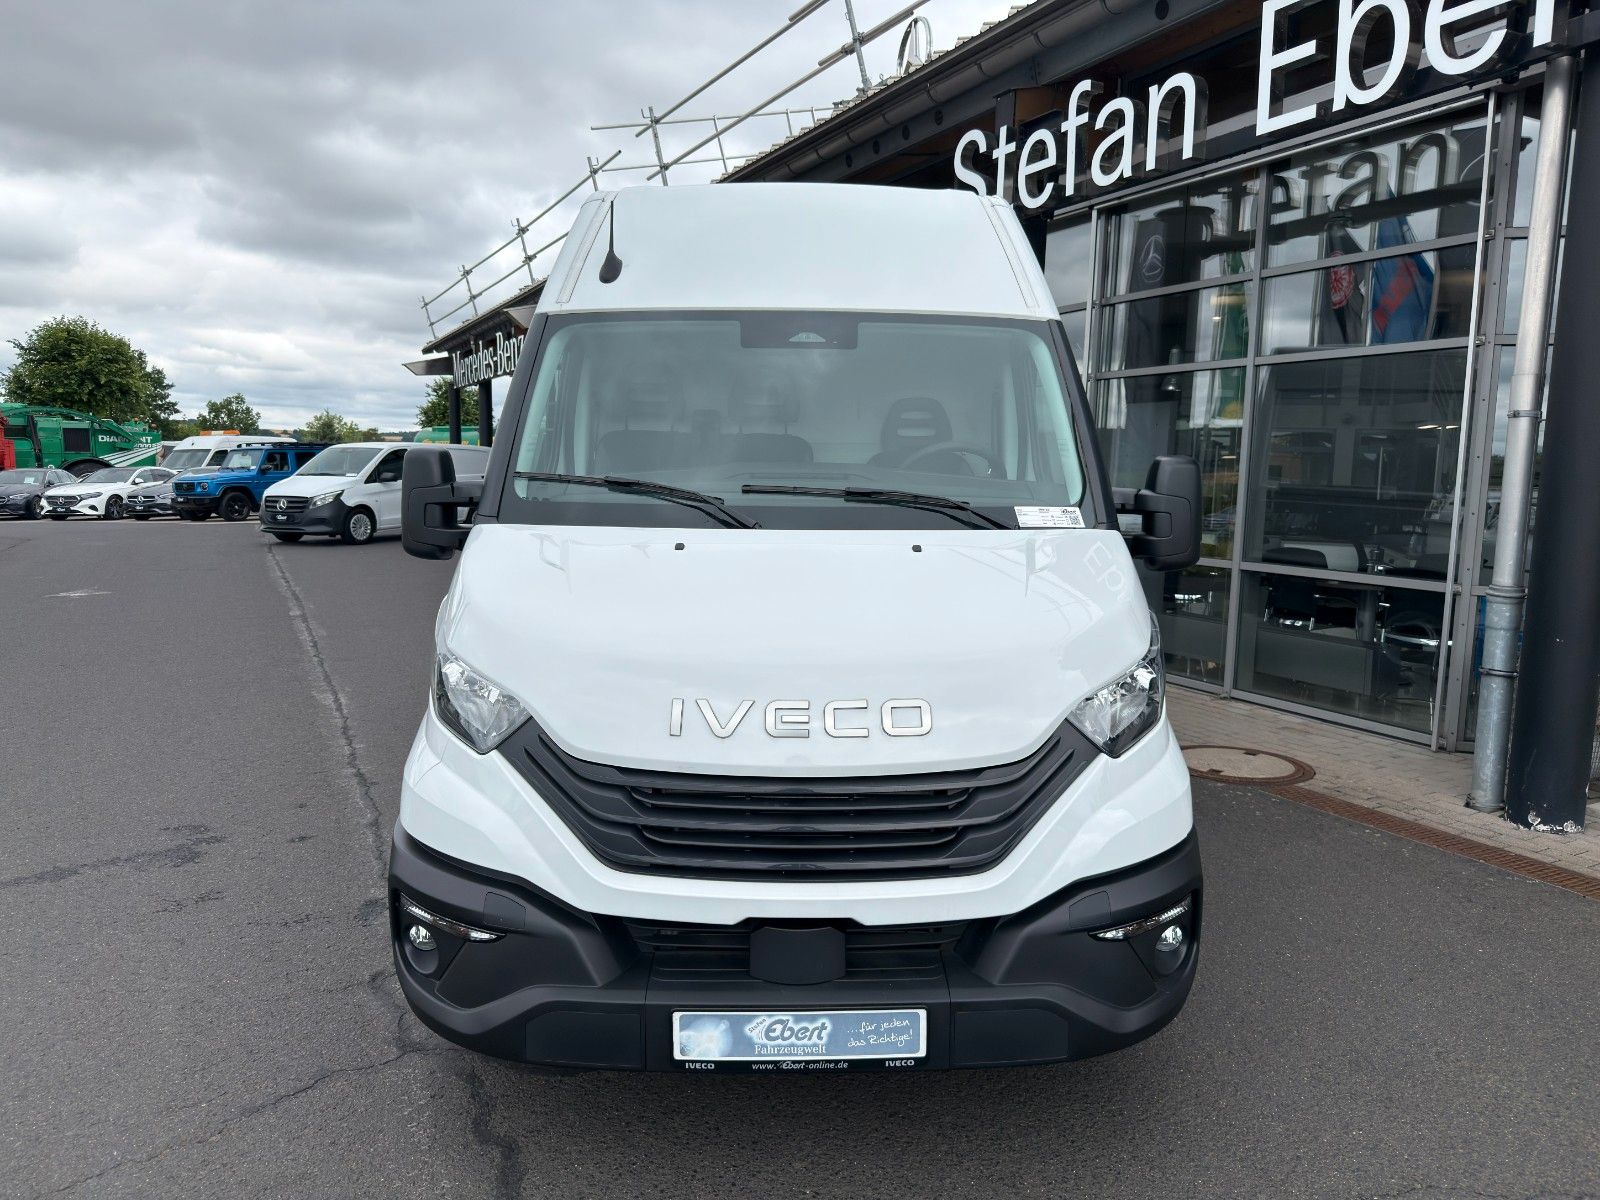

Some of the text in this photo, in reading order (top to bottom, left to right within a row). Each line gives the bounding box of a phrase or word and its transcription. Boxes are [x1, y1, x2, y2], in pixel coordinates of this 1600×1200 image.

[953, 71, 1197, 209] Stefan
[669, 697, 932, 738] IVECO
[764, 1018, 828, 1042] Ebert
[880, 1018, 910, 1032] jeden
[847, 1028, 913, 1048] das Richtige!
[754, 1044, 827, 1056] Fahrzeugwelt
[685, 1062, 715, 1070] IVECO
[885, 1059, 915, 1067] IVECO
